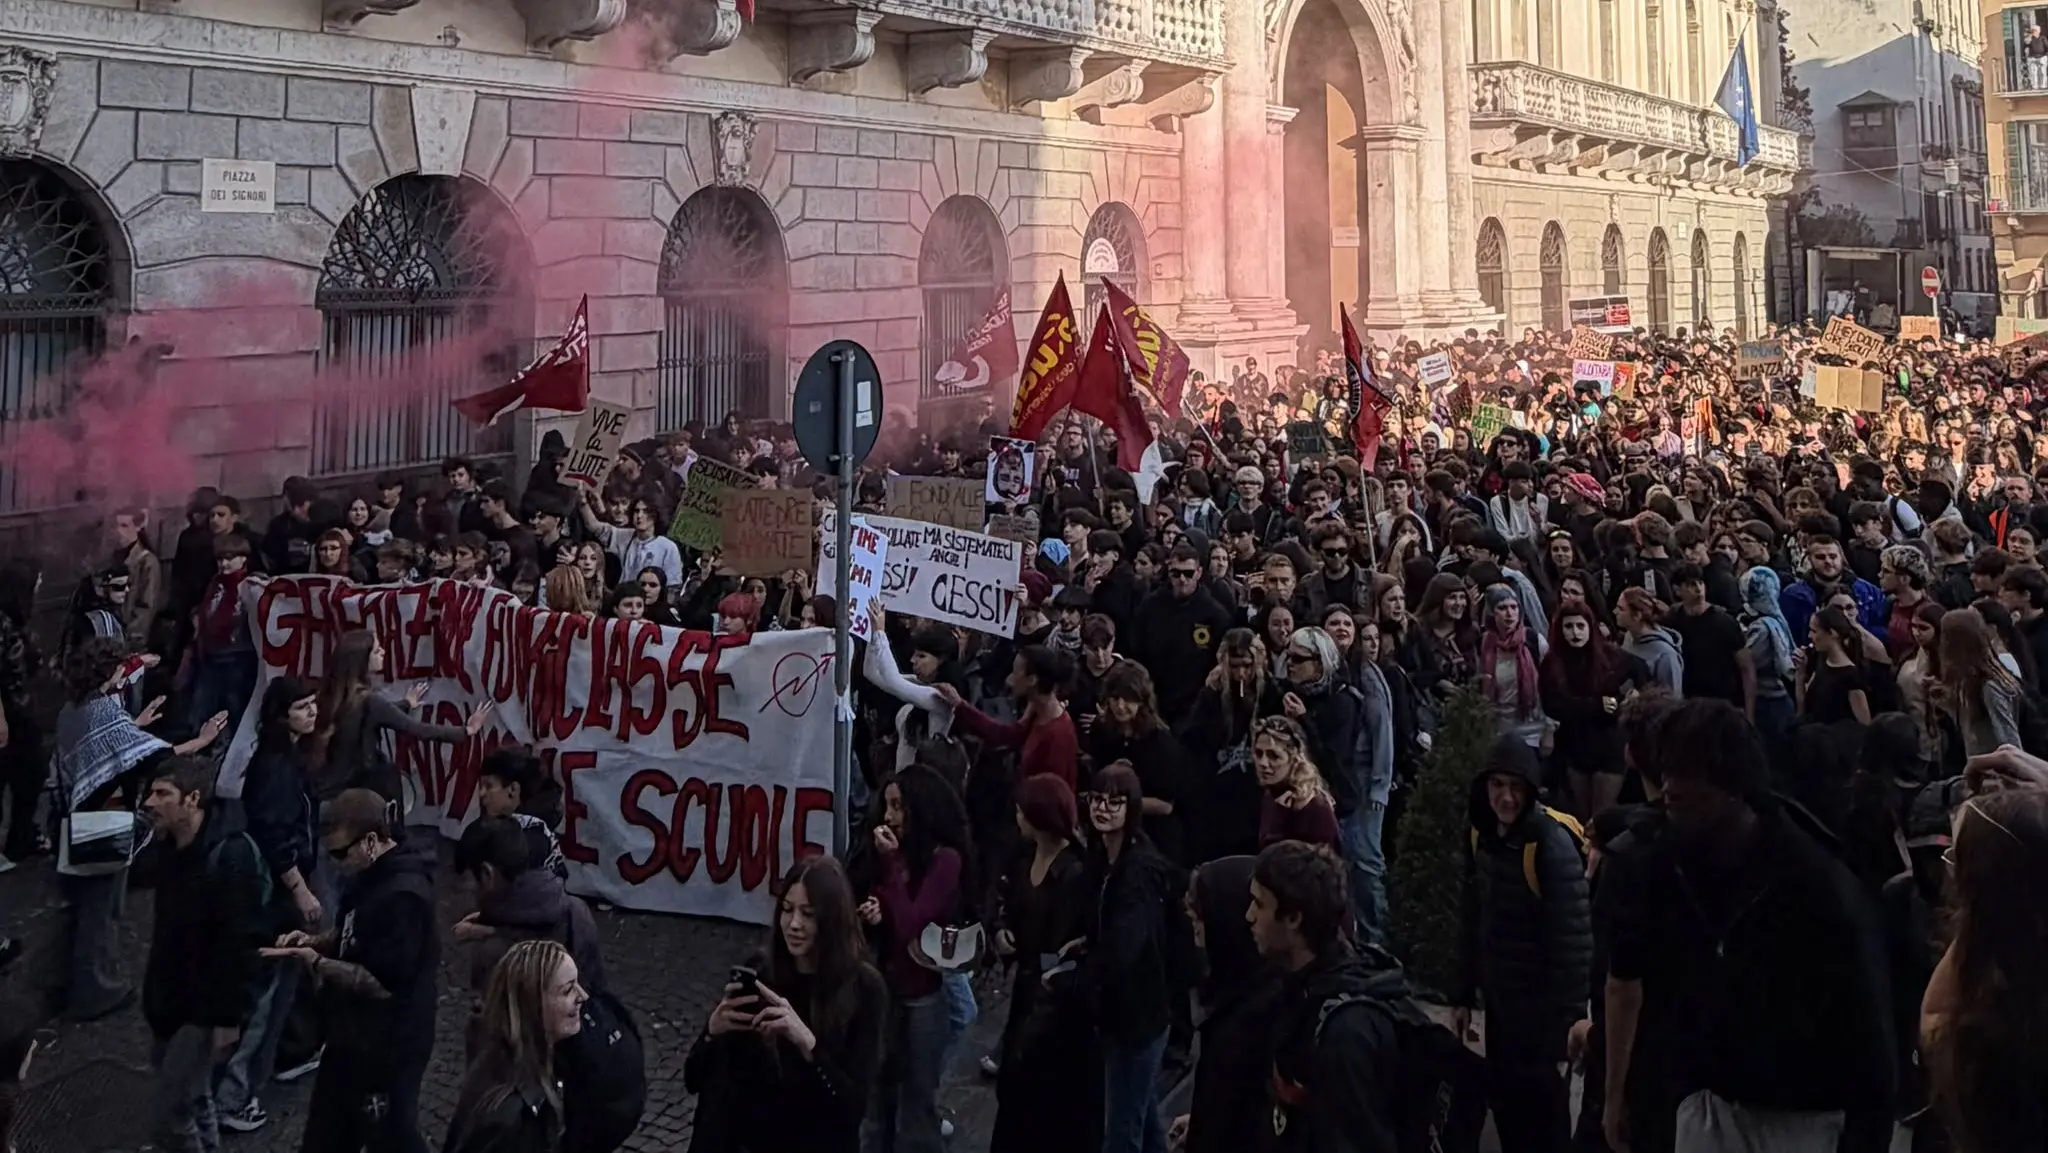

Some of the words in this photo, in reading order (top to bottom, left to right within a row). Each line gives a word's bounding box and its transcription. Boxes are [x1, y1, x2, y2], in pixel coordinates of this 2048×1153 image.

[223, 170, 256, 182] PIAZZA
[211, 189, 226, 201] DEI
[232, 190, 266, 202] SIGNORI
[593, 406, 626, 436] VIVE
[568, 449, 609, 477] LUTTE
[923, 526, 941, 546] MA
